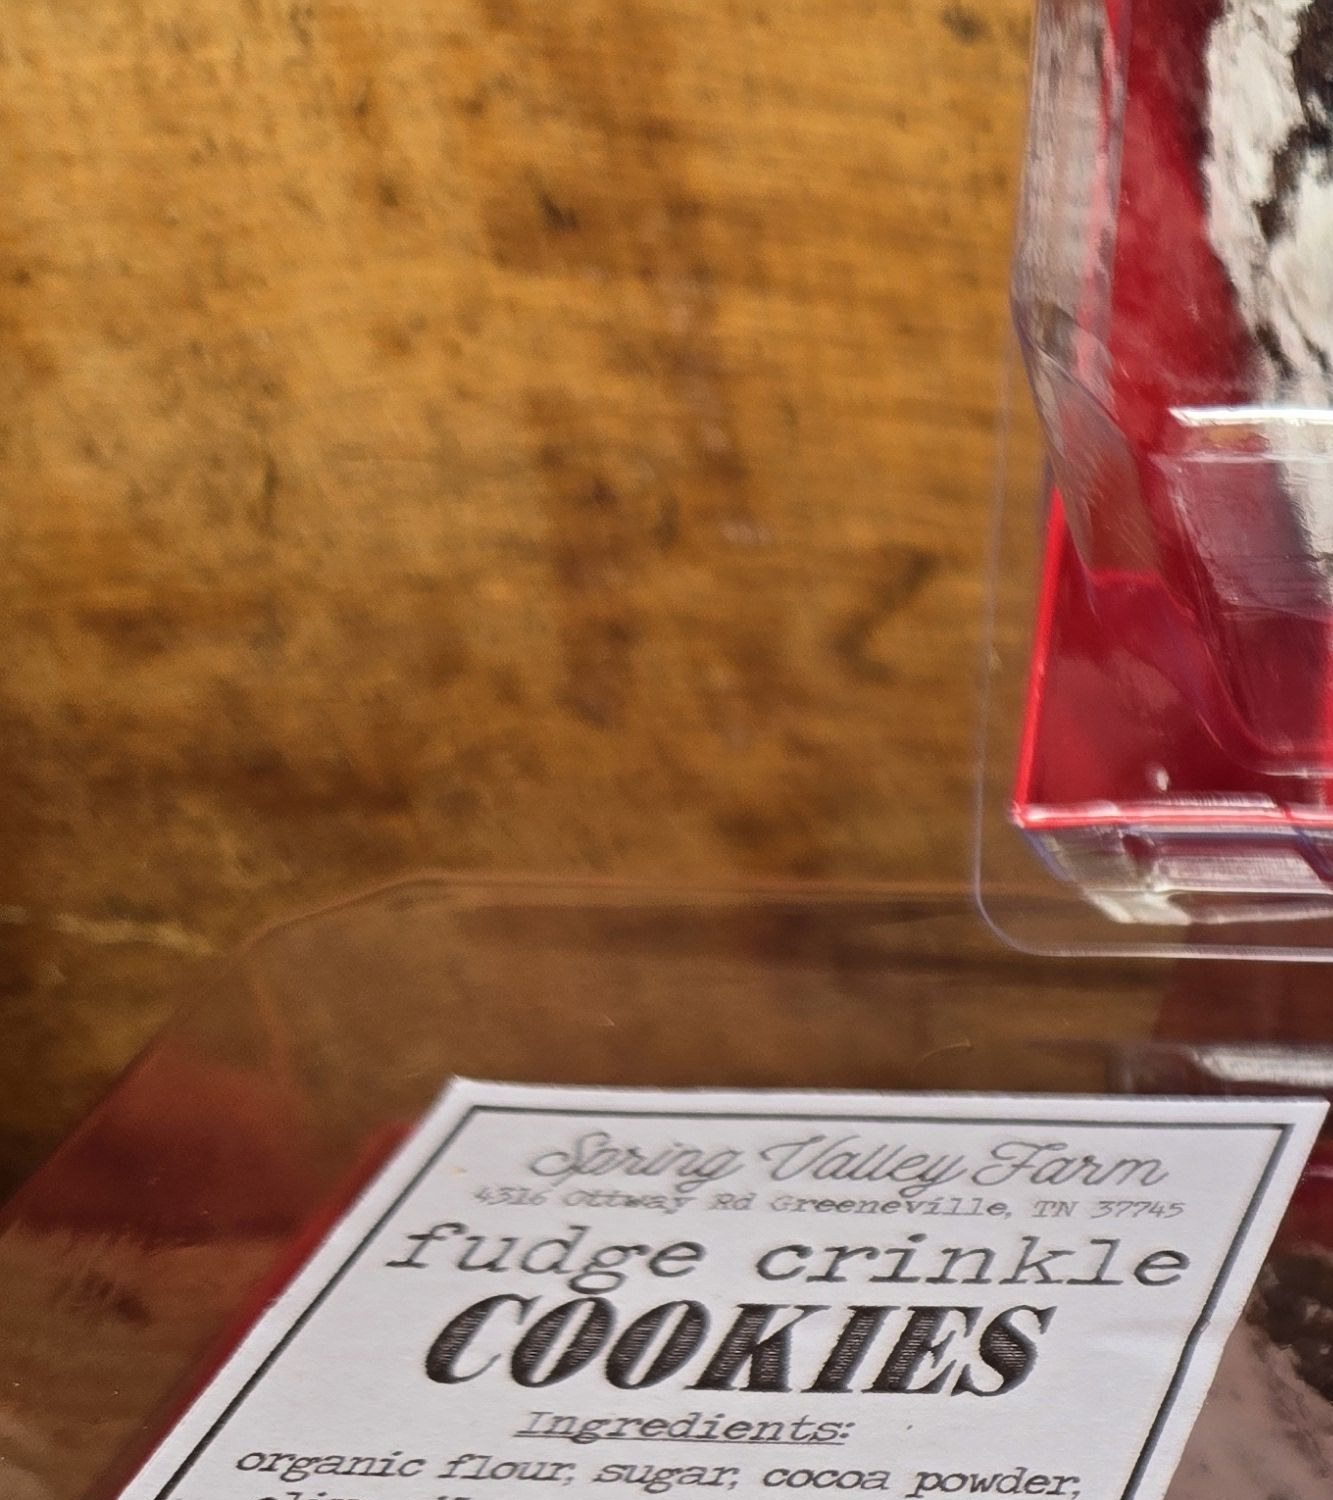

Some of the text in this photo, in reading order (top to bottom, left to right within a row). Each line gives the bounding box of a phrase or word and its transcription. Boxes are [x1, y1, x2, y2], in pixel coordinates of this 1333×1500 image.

[529, 1130, 1171, 1198] Spring Valley Farm
[563, 1189, 697, 1214] Ottway
[708, 1191, 757, 1211] Rd
[770, 1195, 1012, 1220] Greeneville,
[1031, 1199, 1078, 1218] TN
[1091, 1200, 1187, 1218] 37745
[385, 1221, 1192, 1294] fudge crinkle
[425, 1293, 1059, 1397] COOKIES
[513, 1411, 857, 1445] Ingredients:
[236, 1450, 1081, 1500] organic flour, sugar, cocoa powder,
